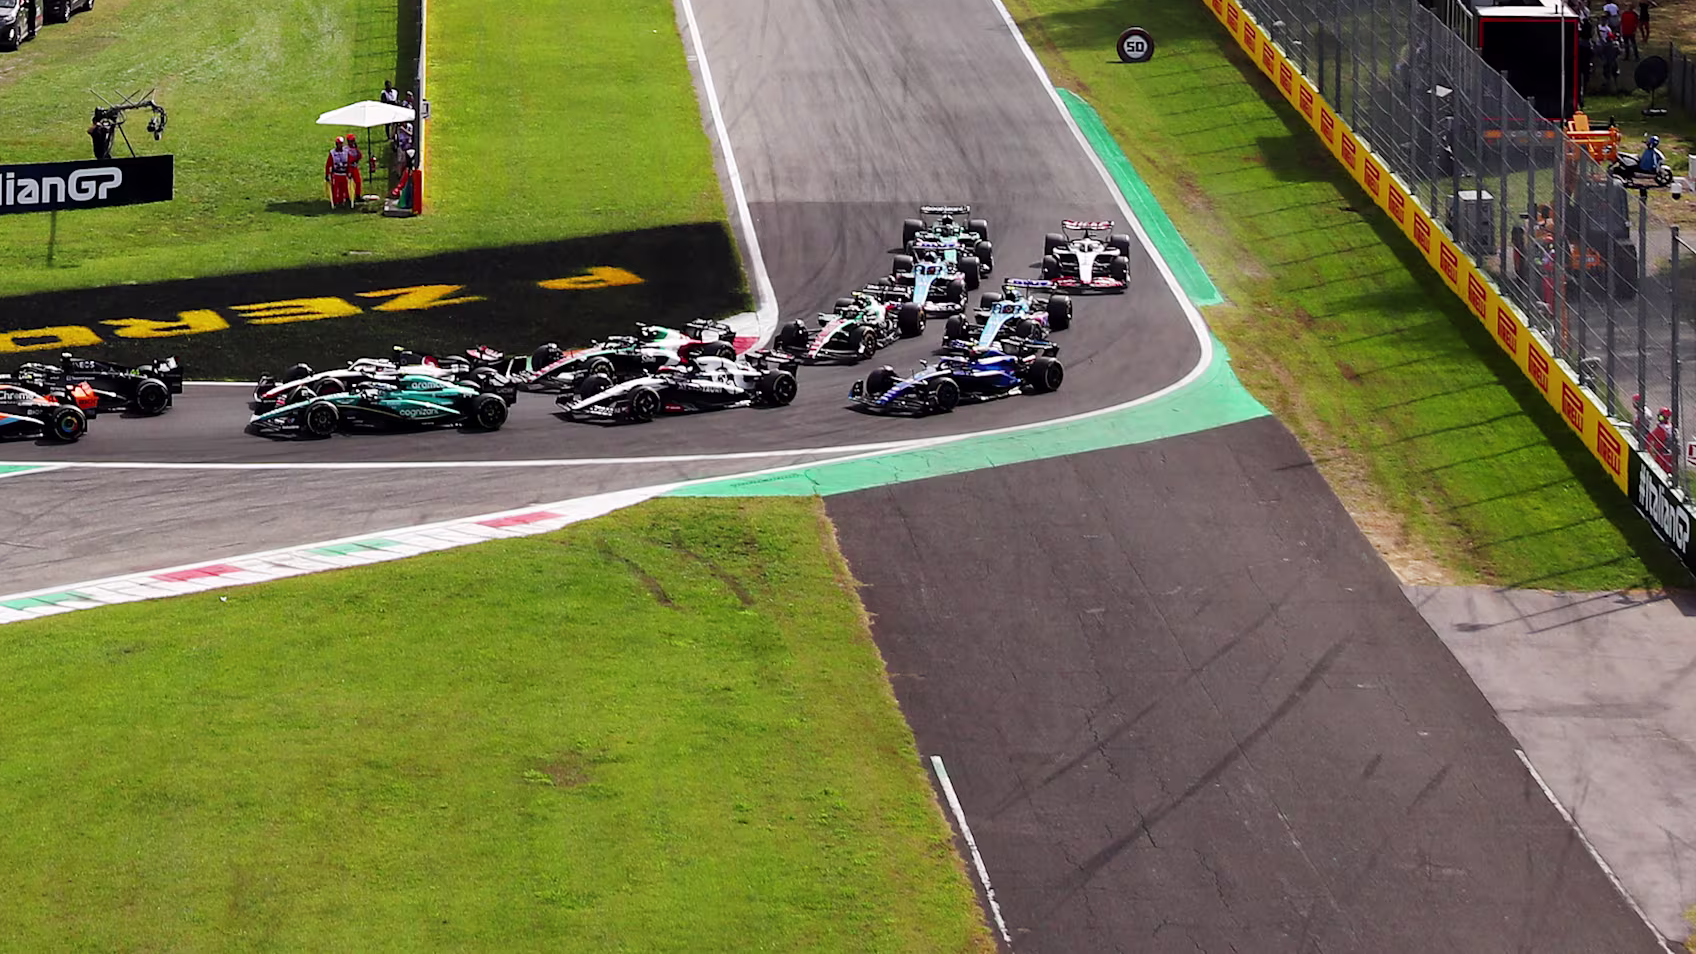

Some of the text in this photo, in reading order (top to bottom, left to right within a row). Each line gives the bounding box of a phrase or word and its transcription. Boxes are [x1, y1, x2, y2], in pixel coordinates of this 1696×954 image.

[1127, 42, 1144, 52] 50
[1468, 272, 1486, 319] PIRELLI
[1498, 306, 1516, 355] PIRELLI
[1528, 342, 1548, 394] PIRELLI
[1562, 381, 1584, 434] PIRELLI
[1597, 420, 1620, 476] PIRELLI
[1639, 463, 1690, 554] #ItalianGP
